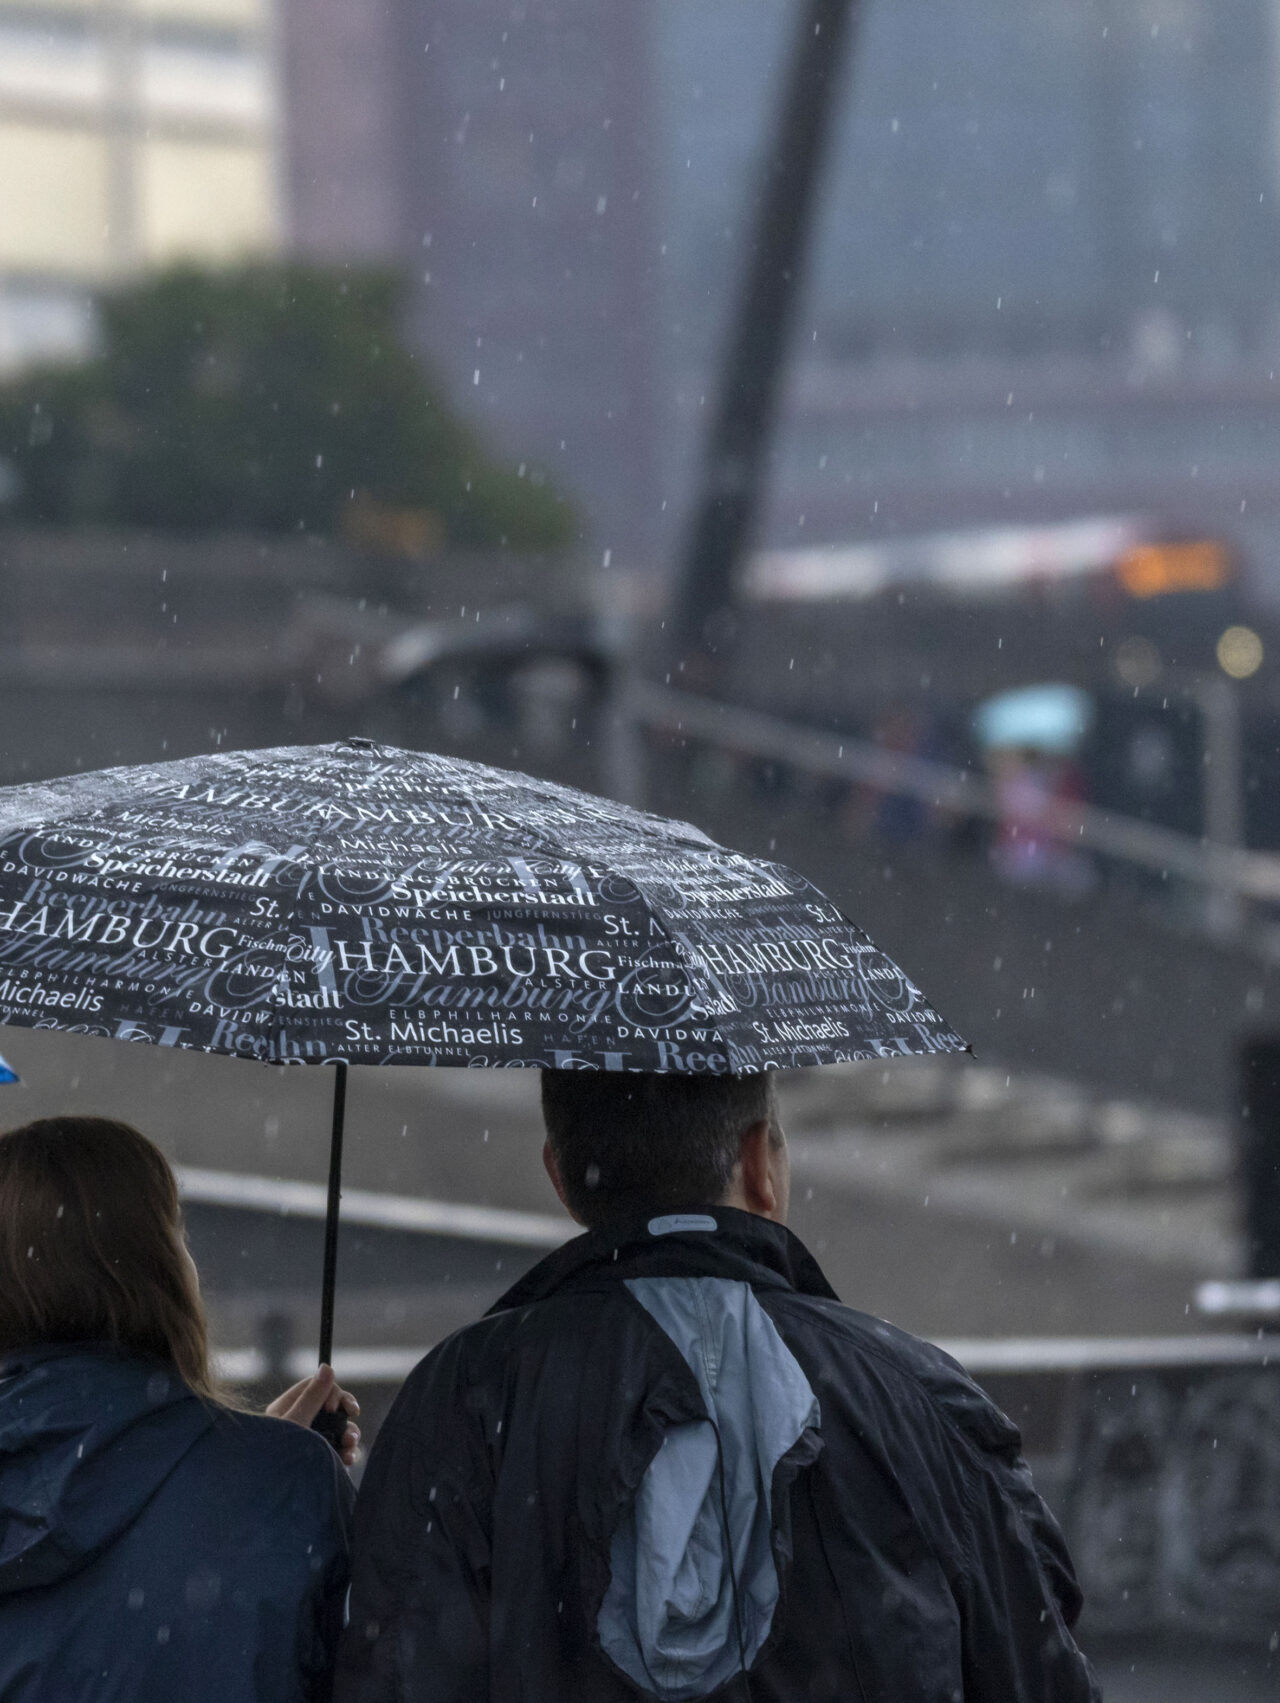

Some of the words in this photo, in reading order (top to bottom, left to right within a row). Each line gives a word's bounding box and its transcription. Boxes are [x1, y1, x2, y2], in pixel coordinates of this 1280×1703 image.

[341, 838, 472, 855] Michaelis
[4, 862, 142, 893] DAVIDWACHE
[84, 852, 270, 888] Speicherstadt
[320, 866, 558, 887] LANDUNGSBRÜCKEN
[23, 879, 227, 926] Reeperbahn
[391, 882, 600, 907] Speicherstadt
[321, 903, 472, 921] DAVIDWACHE
[361, 916, 587, 954] Reeperbahn
[138, 950, 213, 968] ALSTER
[334, 940, 616, 980] HAMBURG
[696, 939, 854, 975] HAMBURG
[525, 978, 608, 990] ALSTER
[390, 1009, 612, 1024] ELBPHILHARMONIE
[345, 1020, 381, 1041] St.
[391, 1021, 523, 1045] Michaelis
[752, 1021, 779, 1044] St.
[774, 1016, 850, 1043] Michaelis
[338, 1044, 380, 1053] ALTER
[388, 1045, 470, 1056] ELBTUNNEL
